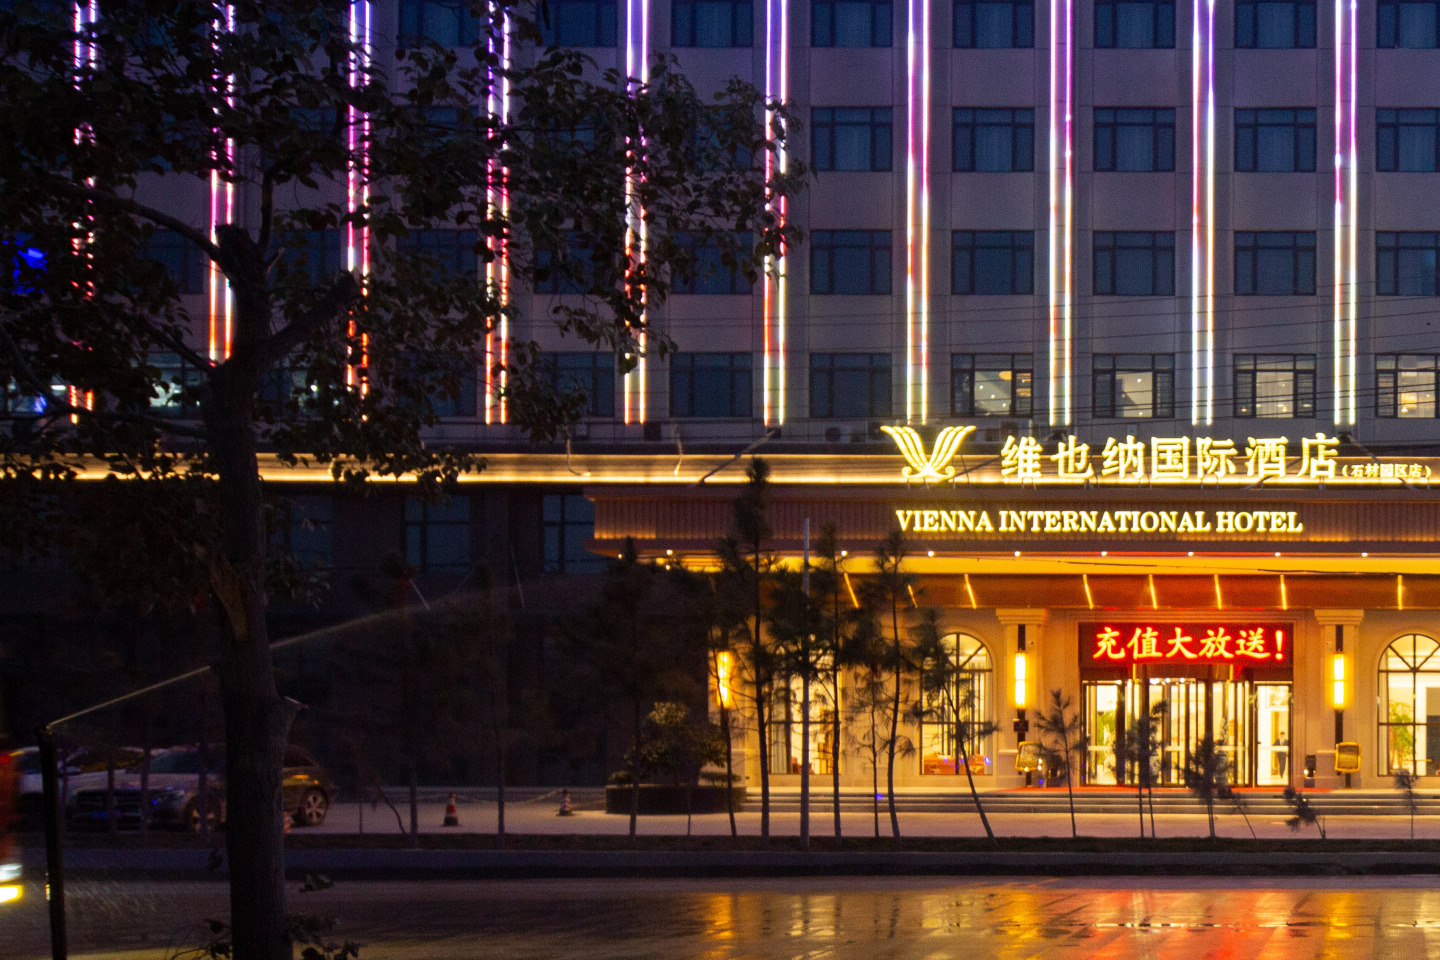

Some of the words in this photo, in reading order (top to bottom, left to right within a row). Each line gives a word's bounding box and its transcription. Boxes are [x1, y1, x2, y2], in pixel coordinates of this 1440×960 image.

[1001, 433, 1341, 480] 维也纳国际酒店
[896, 510, 994, 533] VIENNA
[999, 510, 1212, 533] INTERNATIONAL
[1215, 511, 1304, 533] HOTEL
[1092, 626, 1285, 661] 充值大放送!
